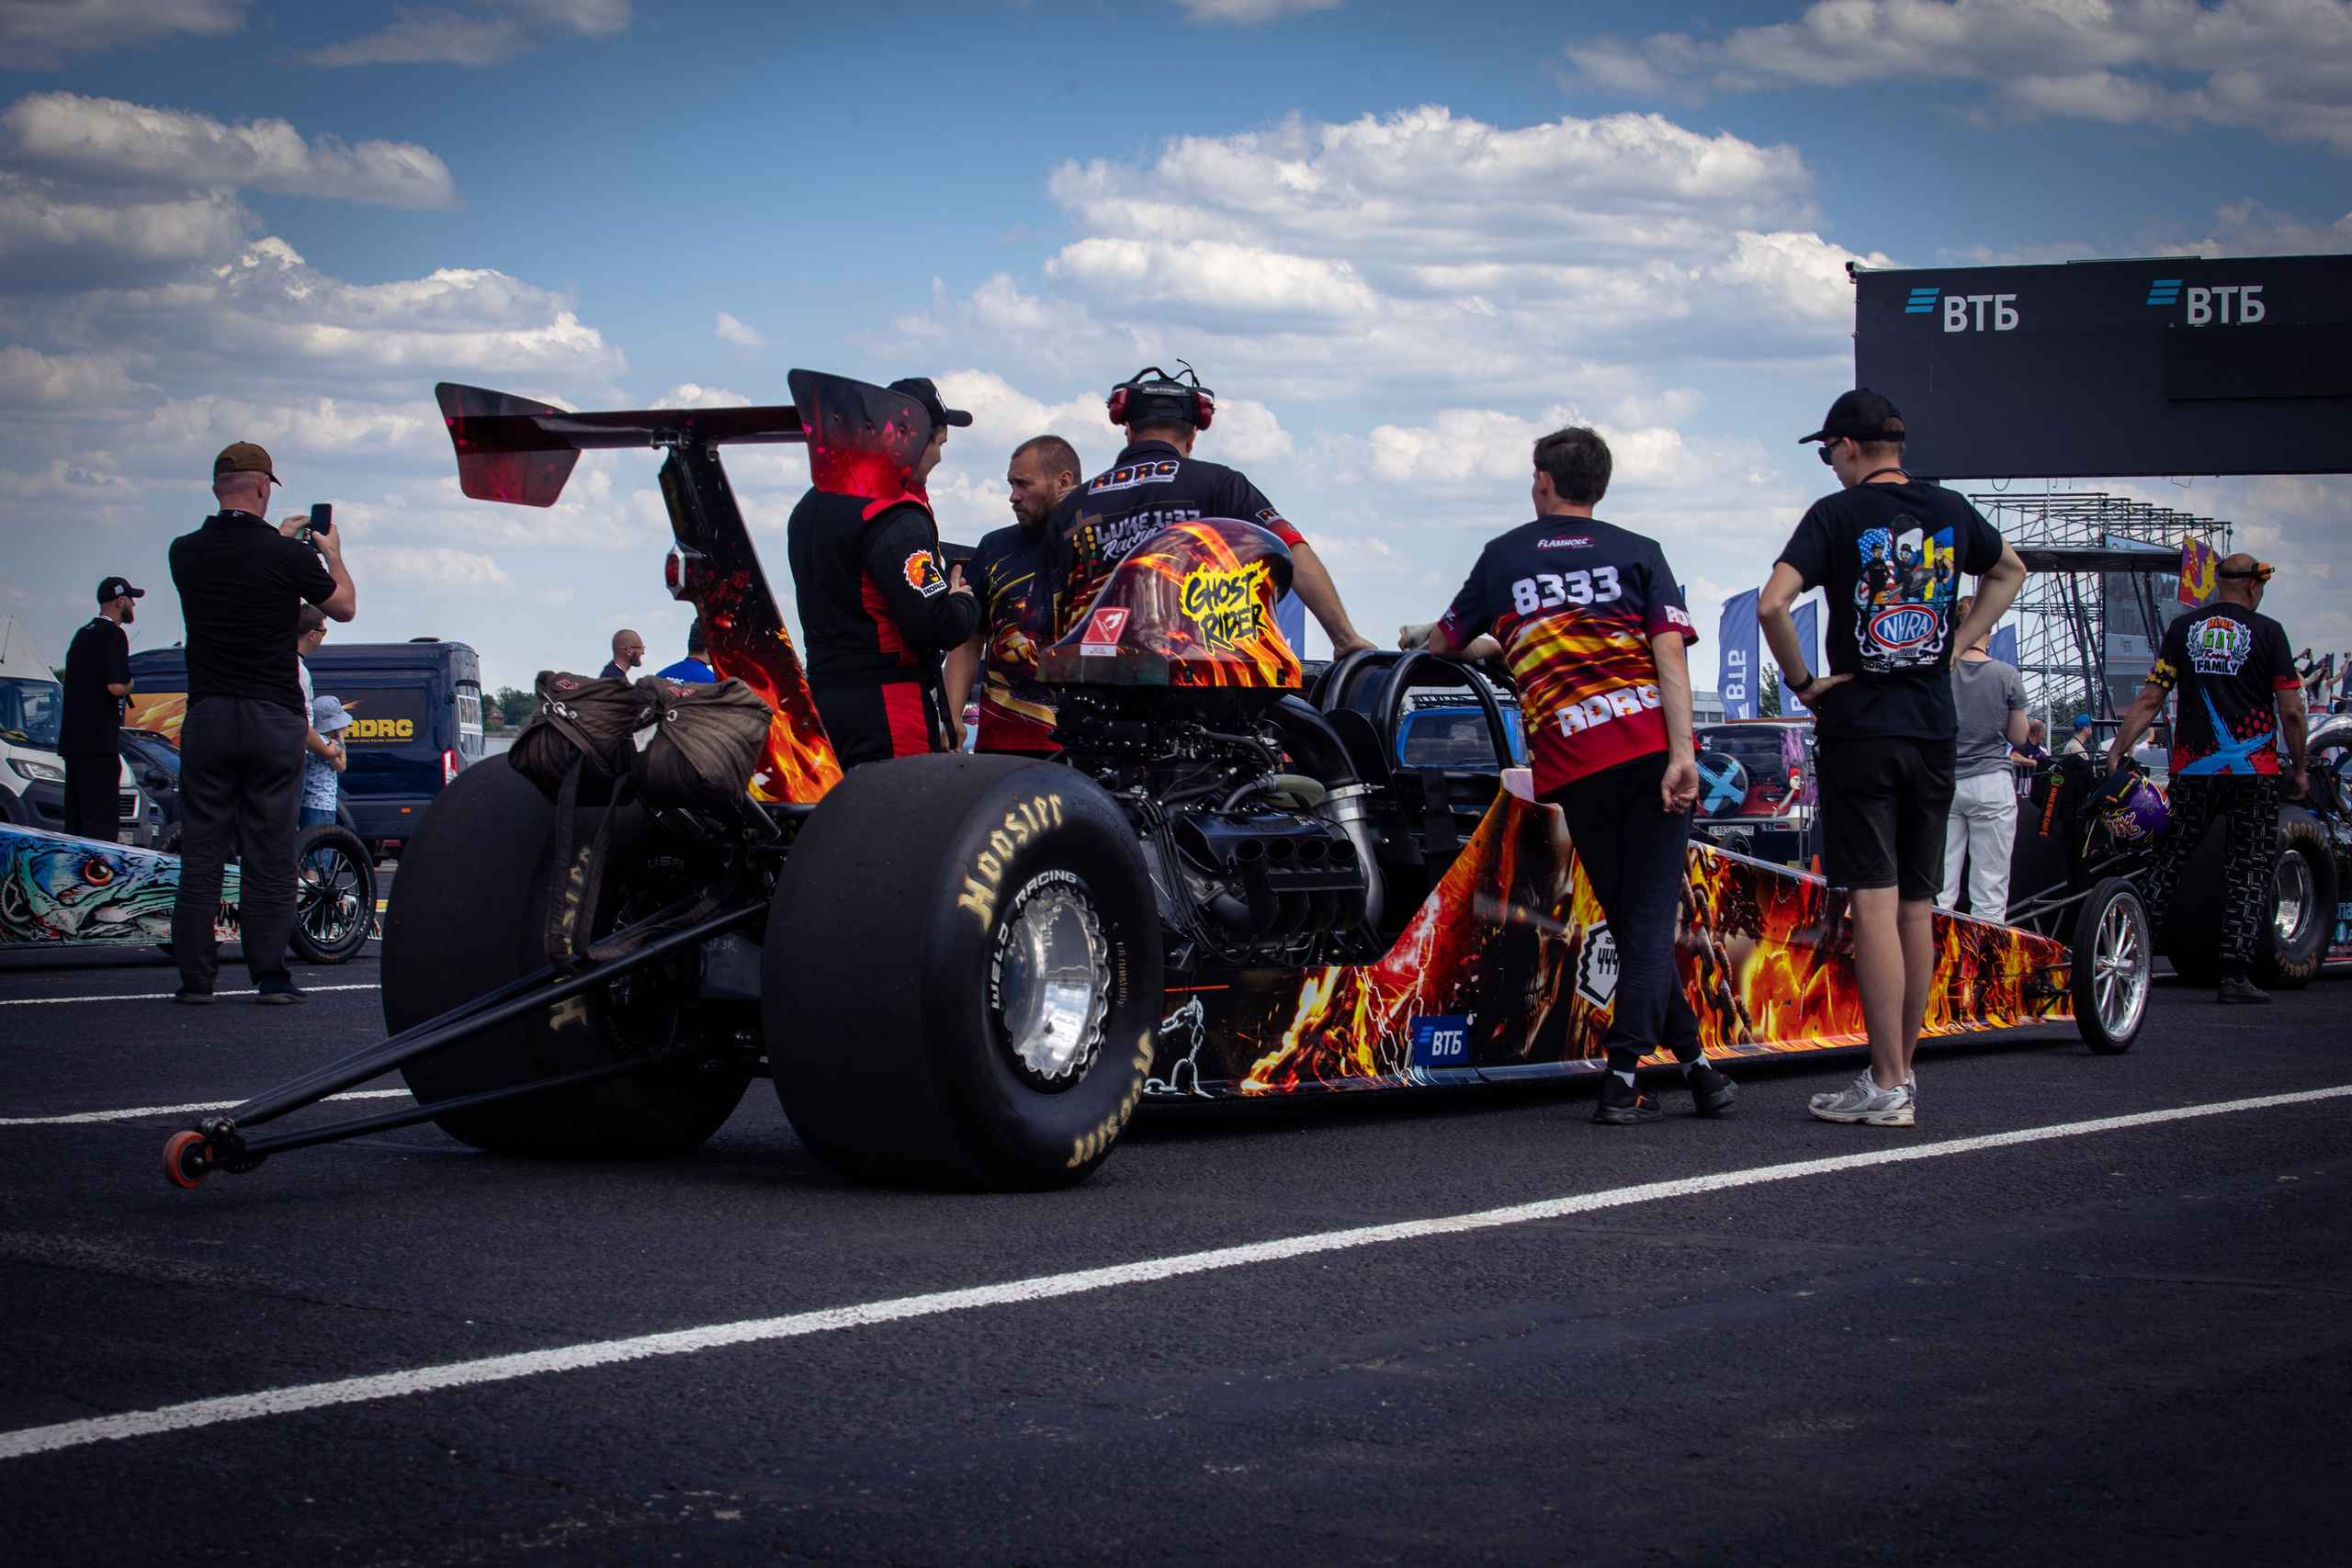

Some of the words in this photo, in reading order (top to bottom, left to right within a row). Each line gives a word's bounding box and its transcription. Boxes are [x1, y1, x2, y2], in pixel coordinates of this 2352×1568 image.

[1944, 294, 2018, 333] ВТБ
[2187, 286, 2266, 324] ВТБ
[1091, 460, 1180, 491] RDRC
[1095, 512, 1149, 544] LUKE
[922, 581, 945, 596] RDRC
[1185, 569, 1259, 615] GHOST
[1511, 565, 1623, 615] 8333
[1200, 604, 1269, 656] RIDER
[1883, 611, 1929, 642] NHRA
[2203, 630, 2237, 649] GAT
[2196, 660, 2239, 674] FAMILY
[345, 718, 413, 737] RDRC
[1555, 683, 1663, 738] RDRC
[957, 794, 1062, 933] Hoosier
[1014, 870, 1077, 909] RACING
[991, 921, 1010, 1010] WELD
[1431, 1031, 1464, 1055] ВТБ
